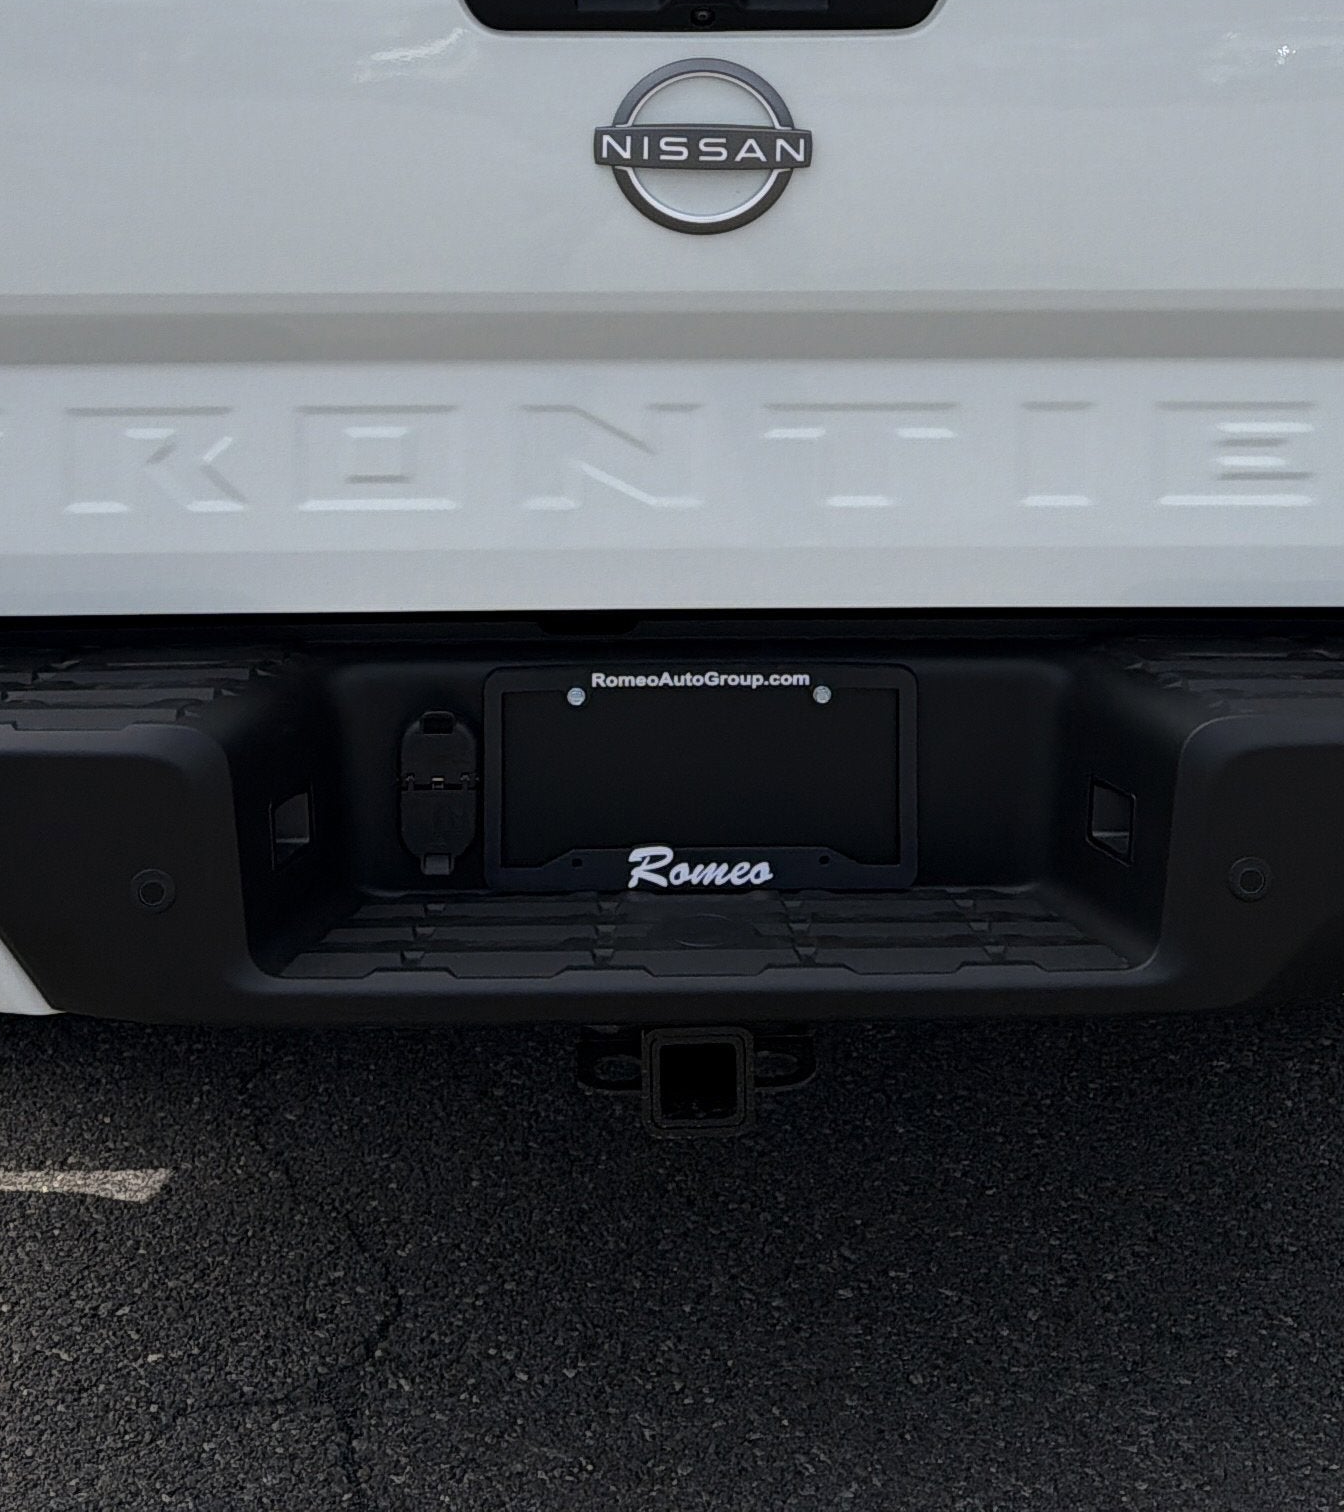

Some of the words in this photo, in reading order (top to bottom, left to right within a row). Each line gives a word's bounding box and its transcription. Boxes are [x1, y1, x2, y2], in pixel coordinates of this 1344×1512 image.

[601, 134, 805, 163] NISSAN
[590, 671, 811, 689] RomeoAutoGroup.com
[627, 845, 774, 889] Romeo
